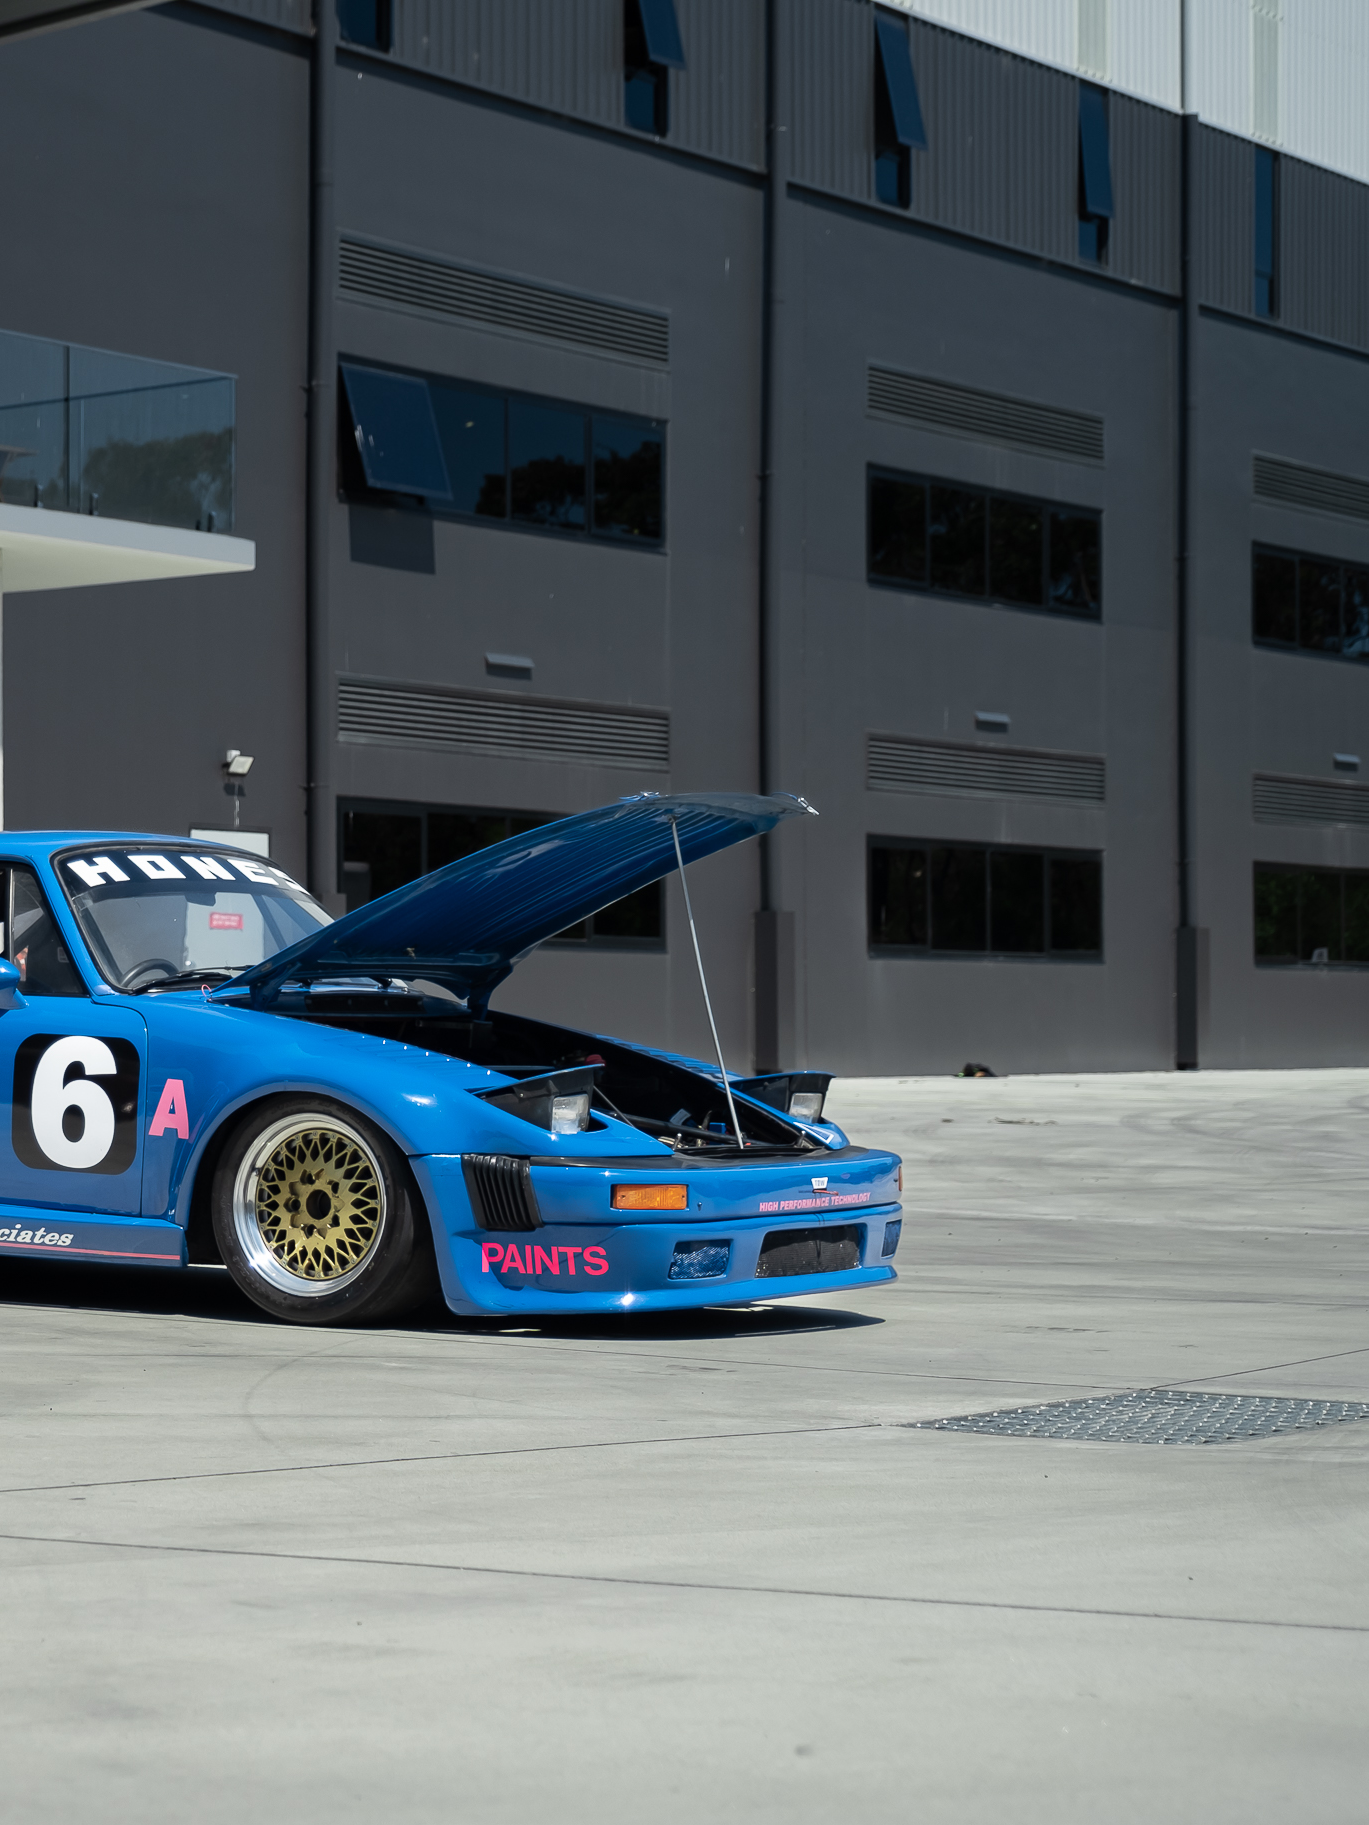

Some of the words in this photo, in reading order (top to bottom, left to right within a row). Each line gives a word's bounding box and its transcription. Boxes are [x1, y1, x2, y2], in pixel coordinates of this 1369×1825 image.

[30, 1035, 118, 1169] 6
[148, 1078, 190, 1140] A
[758, 1201, 779, 1212] HIGH
[779, 1196, 830, 1211] PERFORMANCE
[831, 1192, 871, 1206] TECHNOLOGY
[481, 1242, 610, 1277] PAINTS
